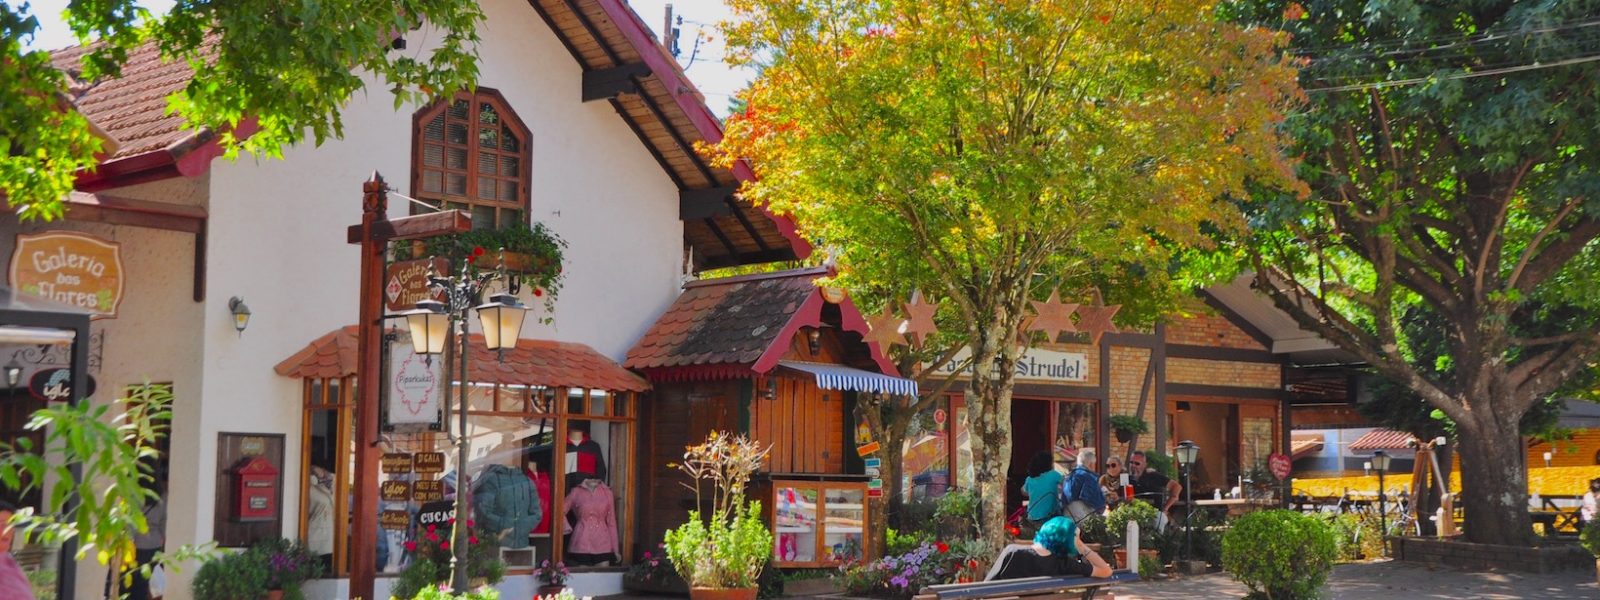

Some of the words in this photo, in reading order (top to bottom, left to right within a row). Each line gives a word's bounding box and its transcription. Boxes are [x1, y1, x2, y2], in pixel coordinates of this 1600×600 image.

[32, 246, 105, 278] Galeria
[399, 262, 442, 284] Galer
[38, 280, 98, 308] Flores
[1015, 354, 1081, 378] Strudel
[43, 383, 71, 400] iglo
[384, 481, 407, 497] igloo
